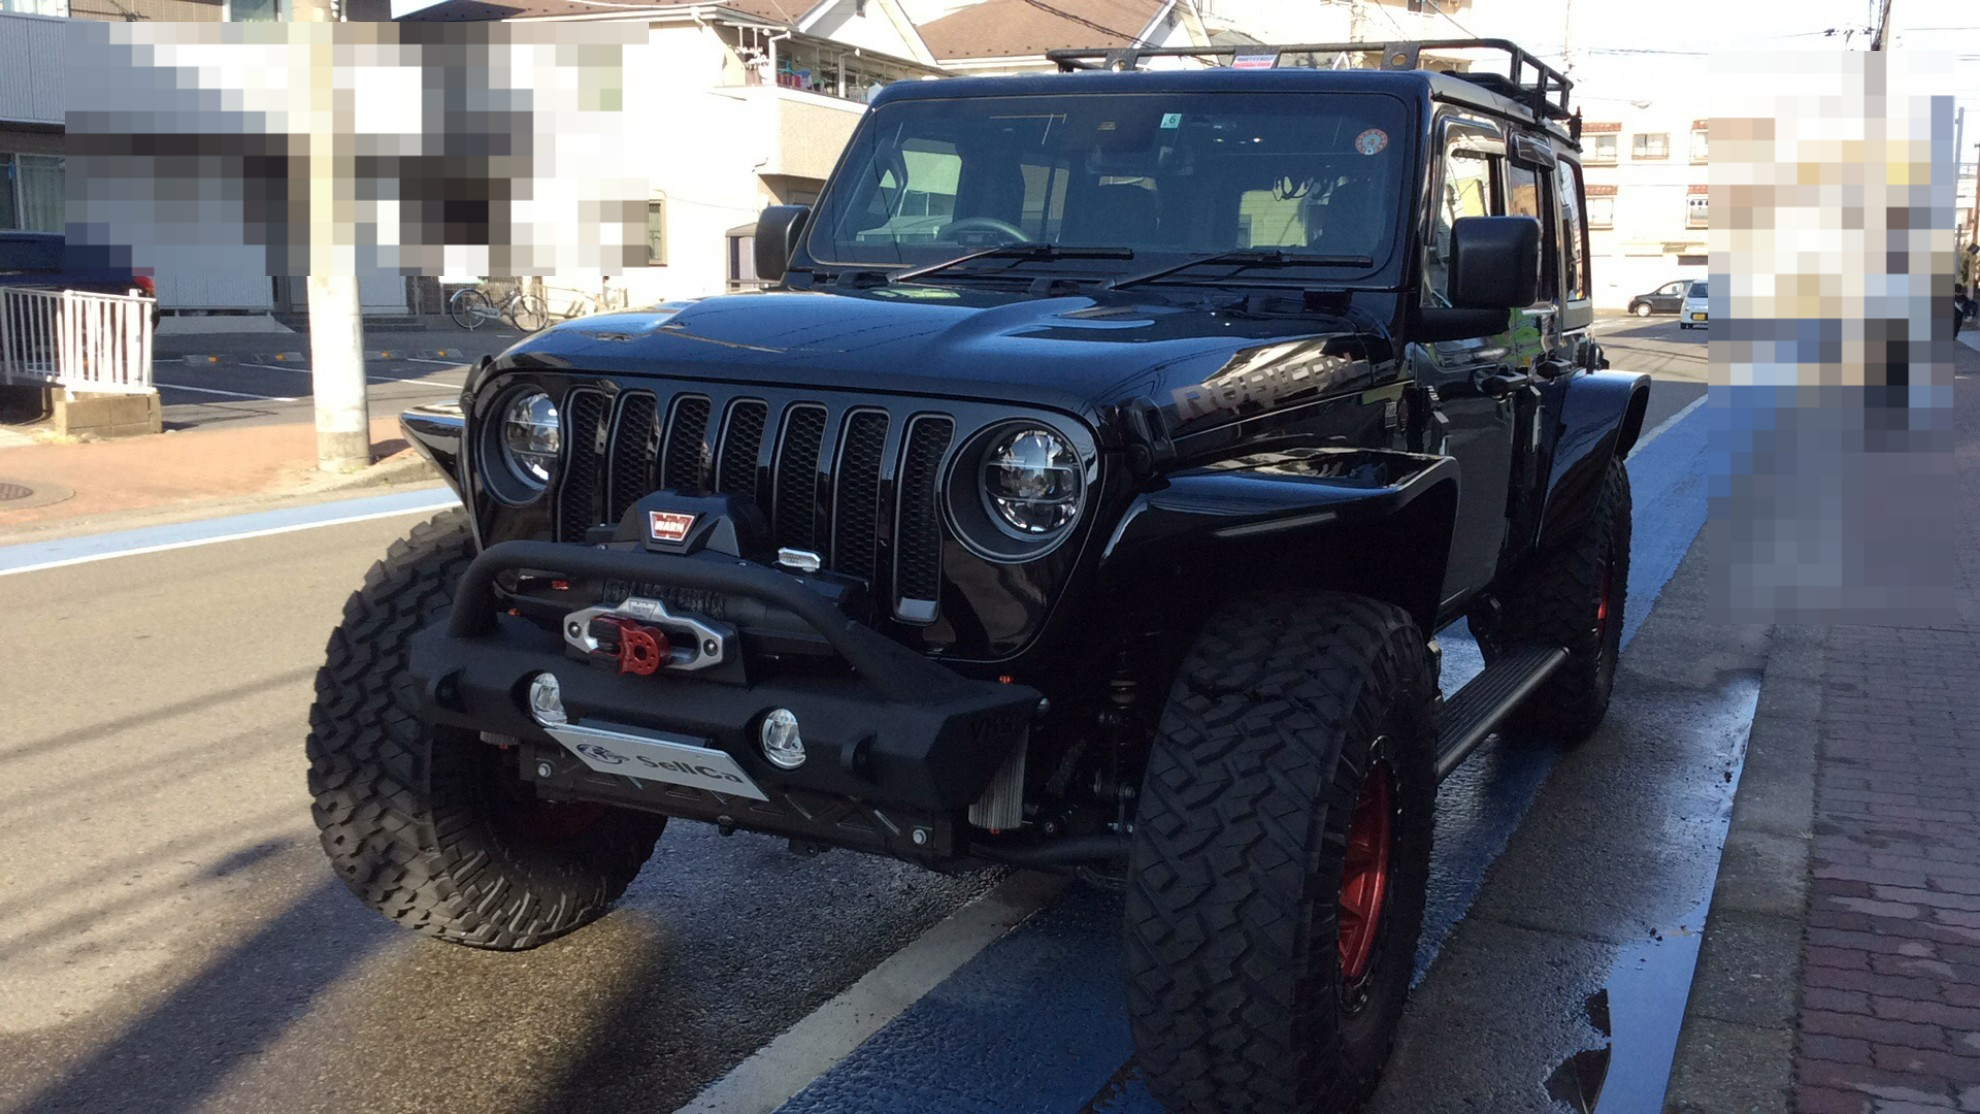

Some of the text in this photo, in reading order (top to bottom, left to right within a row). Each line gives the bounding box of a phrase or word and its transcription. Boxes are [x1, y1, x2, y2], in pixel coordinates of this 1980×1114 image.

[1169, 115, 1177, 124] 6
[1170, 353, 1361, 421] RUBICON
[654, 520, 685, 533] WARN
[636, 755, 744, 784] SellCa
